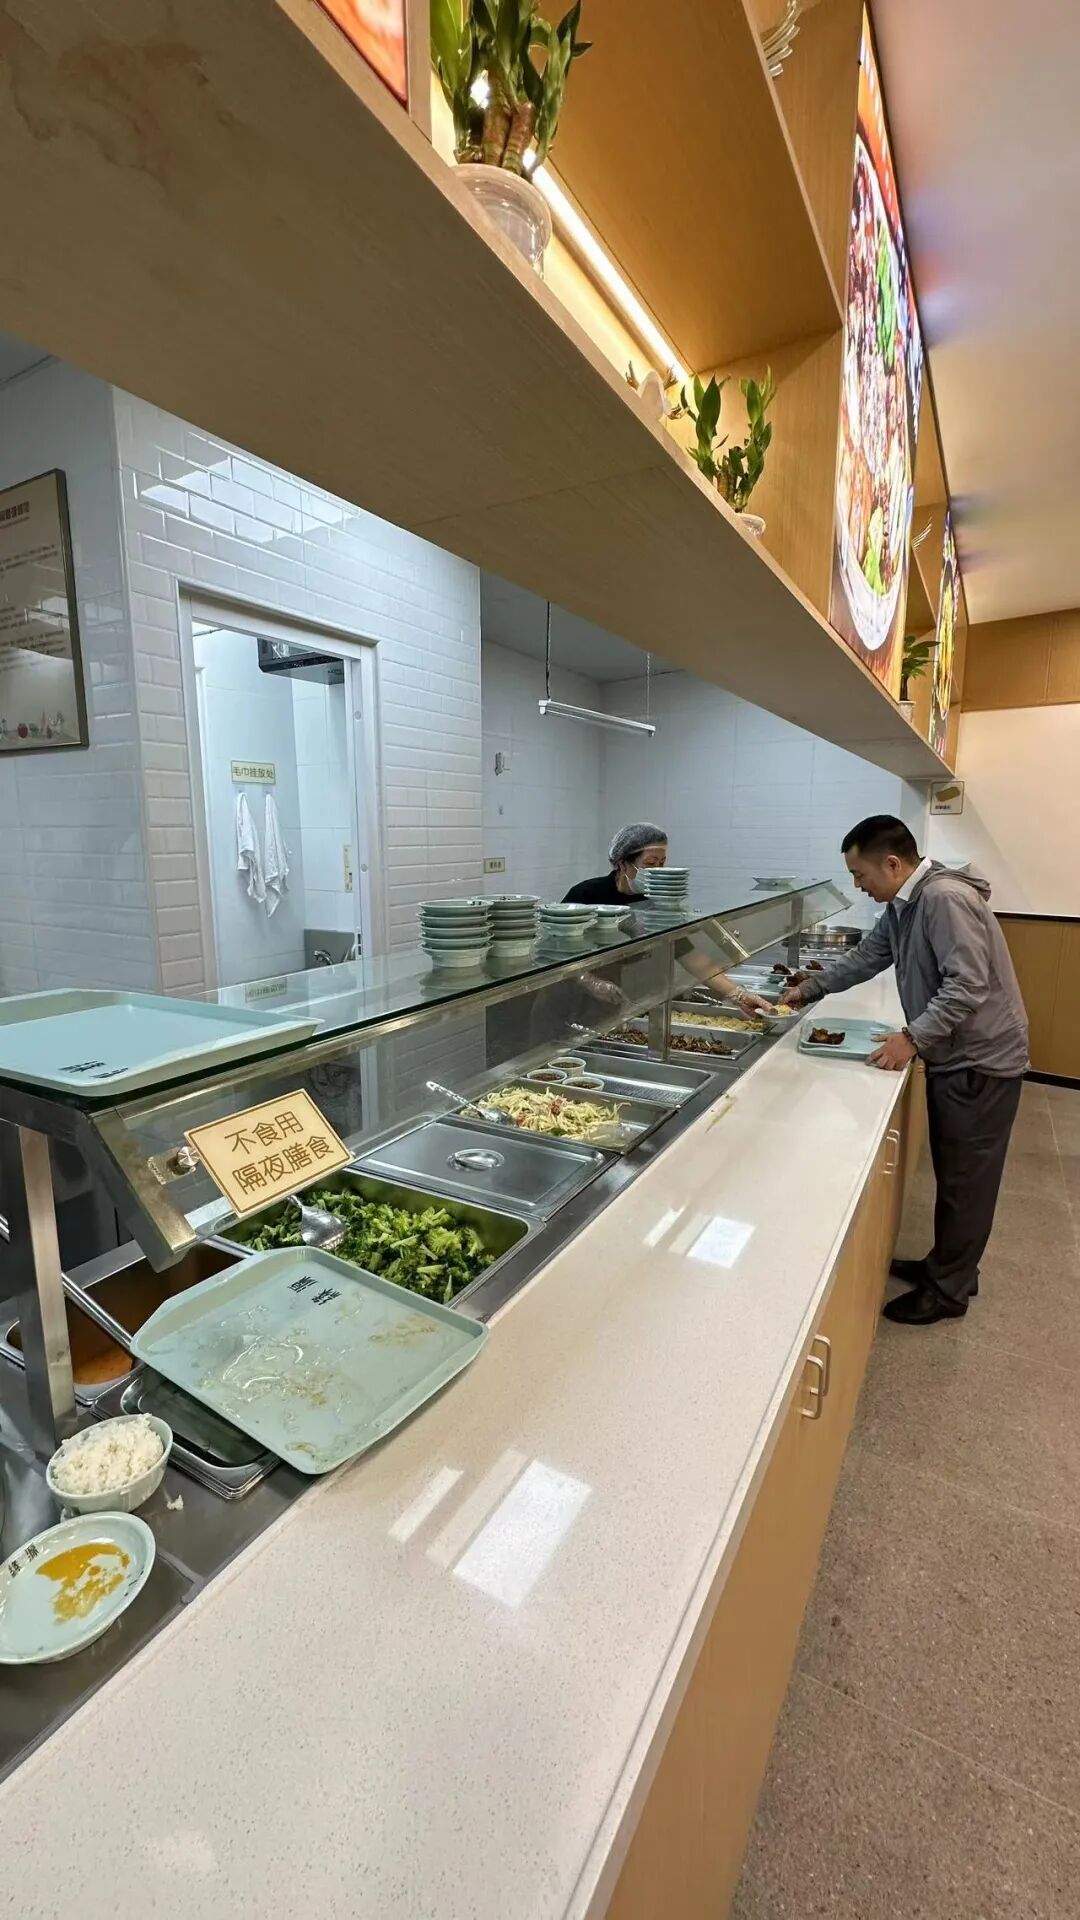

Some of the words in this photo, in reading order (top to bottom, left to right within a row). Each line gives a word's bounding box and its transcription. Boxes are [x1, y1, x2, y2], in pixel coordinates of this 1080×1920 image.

[232, 766, 274, 779] 毛巾挂放处
[224, 1110, 304, 1155] 不食用
[232, 1135, 334, 1195] 隔夜膳食
